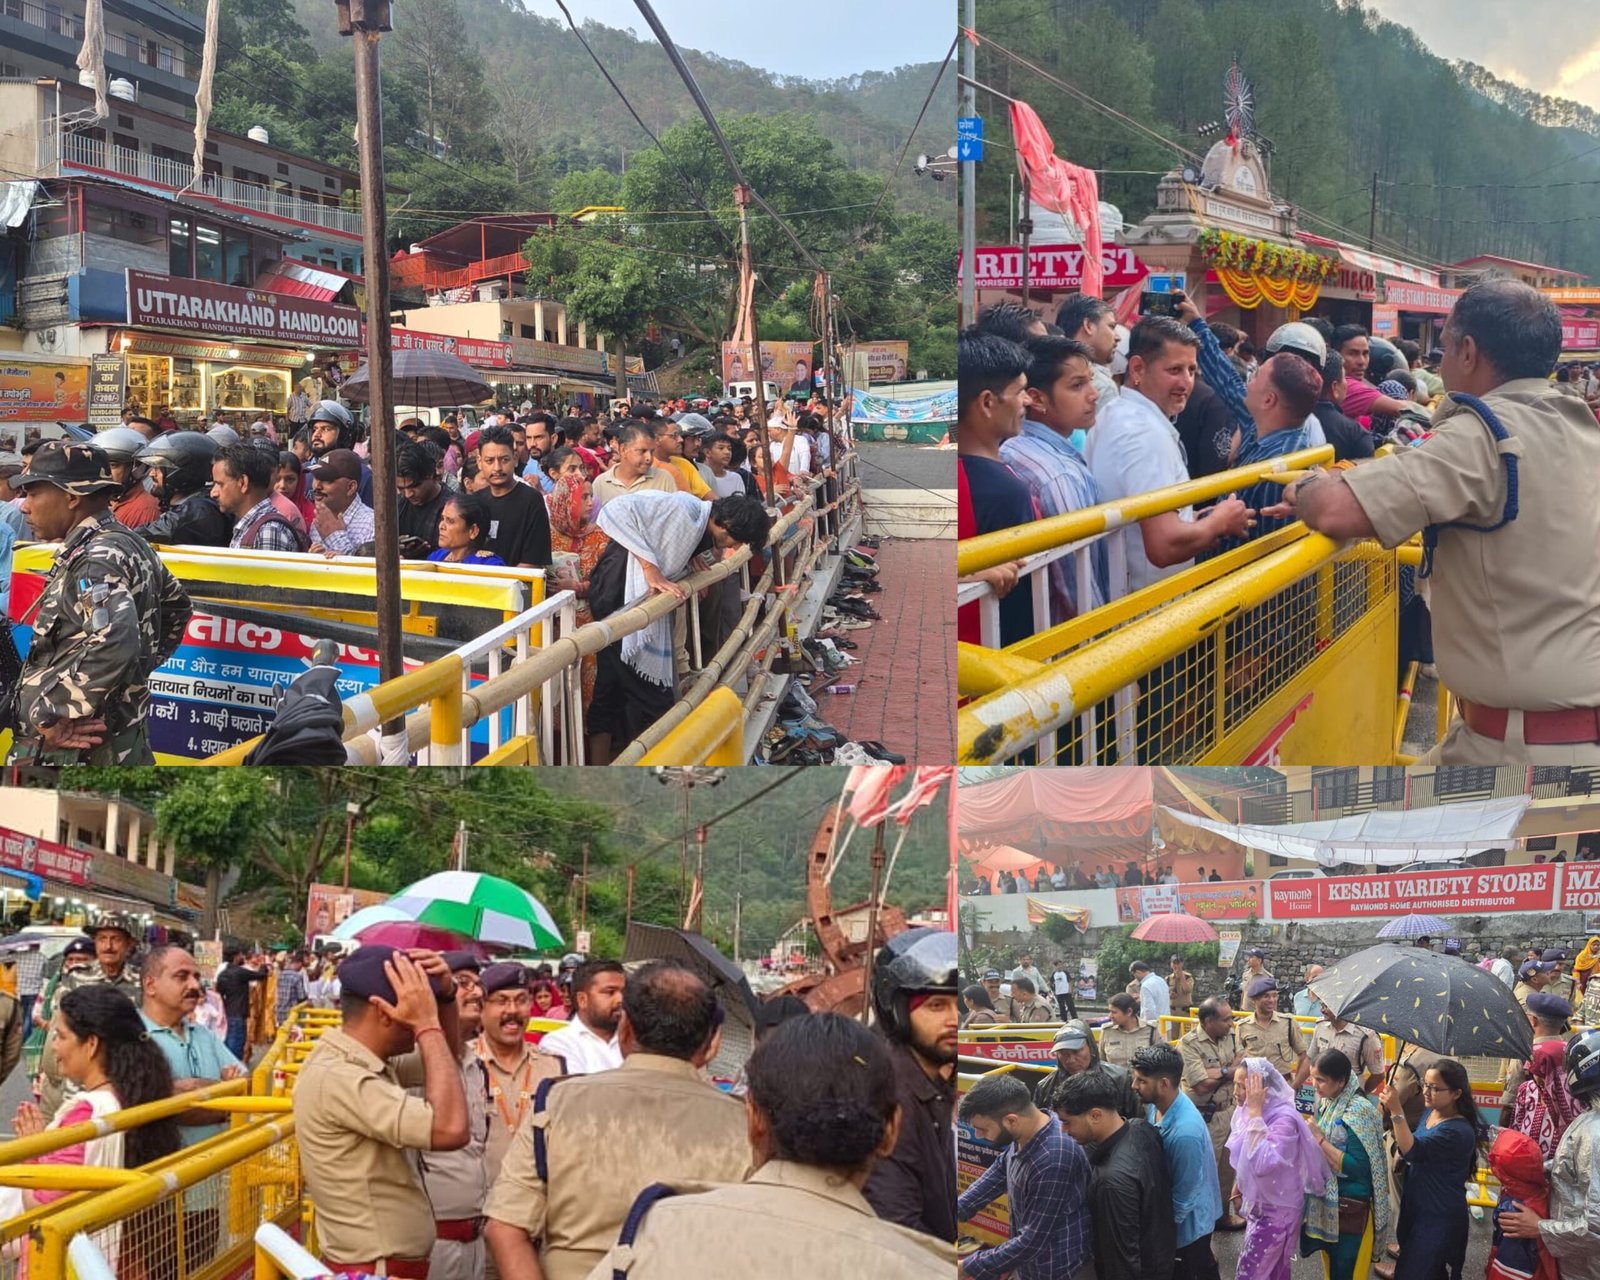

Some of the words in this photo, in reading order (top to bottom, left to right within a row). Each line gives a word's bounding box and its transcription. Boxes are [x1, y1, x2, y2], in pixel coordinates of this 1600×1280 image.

[958, 251, 1083, 280] RIETY
[1101, 249, 1138, 275] ST
[137, 288, 275, 328] UTTARAKHAND
[279, 309, 358, 337] HANDLOOM
[139, 314, 199, 329] UTTARAKHAND
[201, 323, 247, 334] HANDICRAFT
[249, 327, 276, 337] TEXTILE
[277, 331, 320, 341] DEVELOPMENT
[321, 336, 359, 345] CORPORATION
[95, 363, 120, 371] प्रसाद
[101, 373, 114, 381] का
[94, 382, 120, 392] कंबल
[188, 615, 282, 650] ताल
[190, 656, 217, 674] और
[221, 663, 243, 678] हम
[148, 679, 190, 695] ातायात
[193, 681, 236, 701] नियमों
[237, 690, 254, 704] का
[258, 694, 276, 707] पा
[190, 710, 200, 723] 3.
[203, 708, 229, 732] गाड़ी
[231, 715, 262, 733] चलाते
[187, 737, 198, 751] 4.
[1328, 881, 1390, 900] KESARI
[1394, 876, 1473, 898] VARIETY
[1477, 871, 1547, 894] STORE
[1289, 902, 1312, 910] Home
[1350, 902, 1388, 911] RAYMONDS
[1389, 900, 1411, 910] HOME
[1412, 898, 1460, 910] AUTHORISED
[1461, 897, 1515, 907] DISTRIBUTOR
